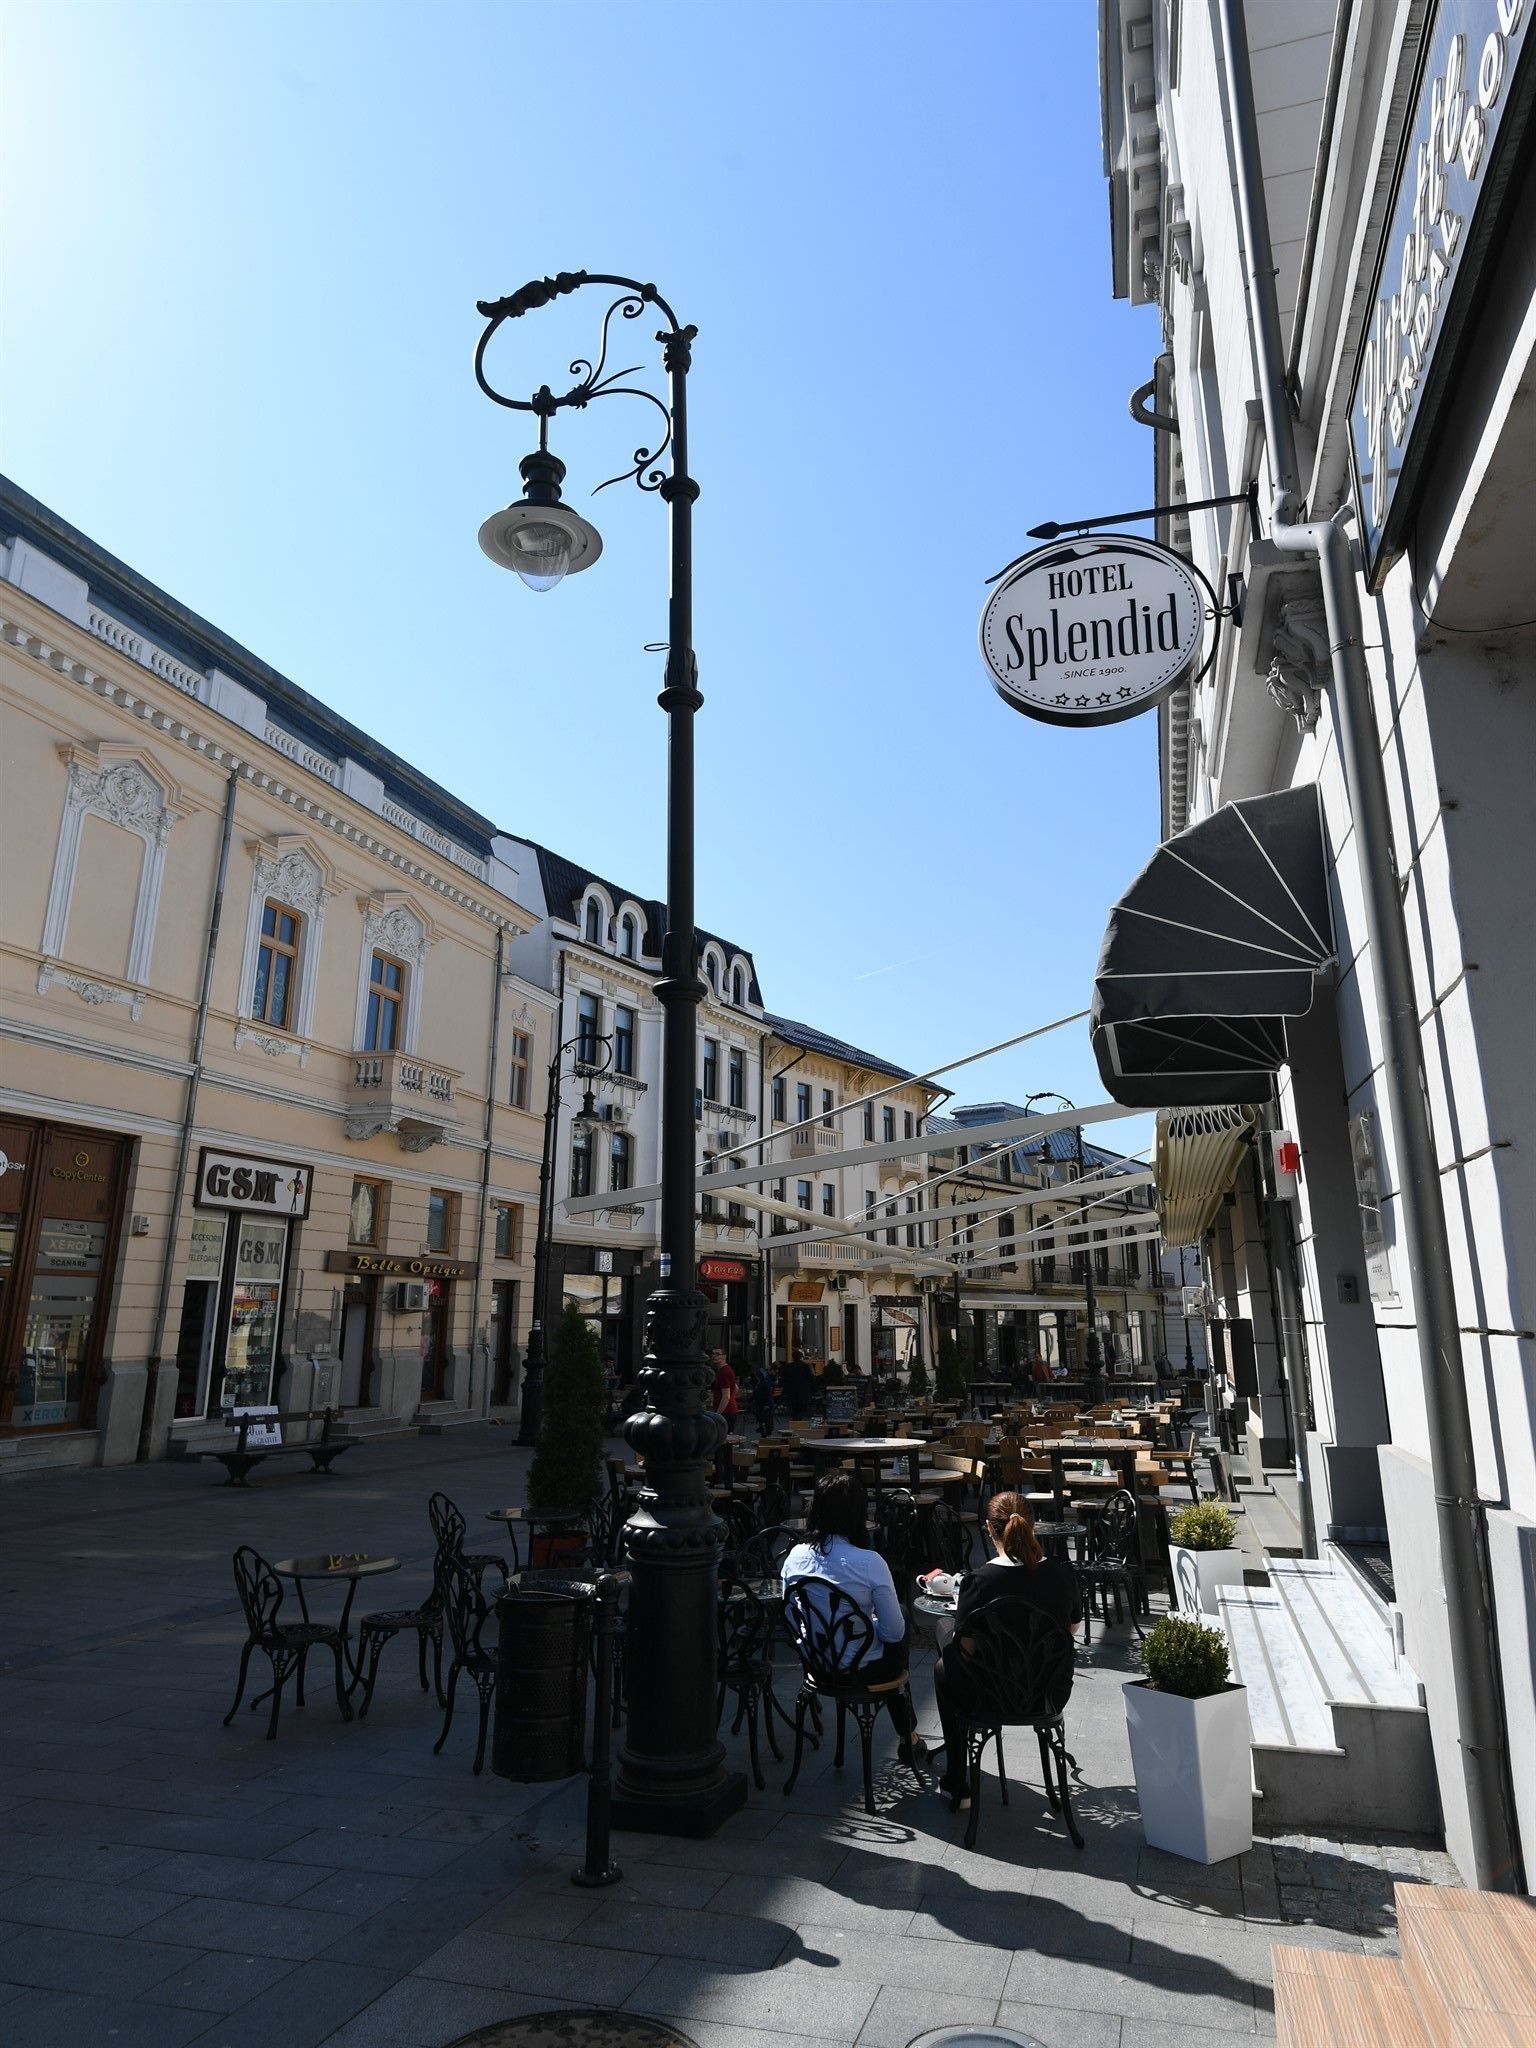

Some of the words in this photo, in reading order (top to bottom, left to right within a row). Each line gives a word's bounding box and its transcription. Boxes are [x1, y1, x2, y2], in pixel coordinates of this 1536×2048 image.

[1389, 209, 1463, 448] BRIDAL
[1048, 563, 1133, 600] HOTEL
[1005, 593, 1181, 682] Splendid
[8, 1161, 26, 1171] GSM
[52, 1167, 106, 1183] CopyCenter
[206, 1164, 280, 1204] GSM
[49, 1239, 93, 1252] XEROX
[239, 1239, 281, 1265] GSM
[50, 1258, 87, 1268] SCANARE
[355, 1255, 401, 1272] Belle
[410, 1261, 465, 1277] Optique
